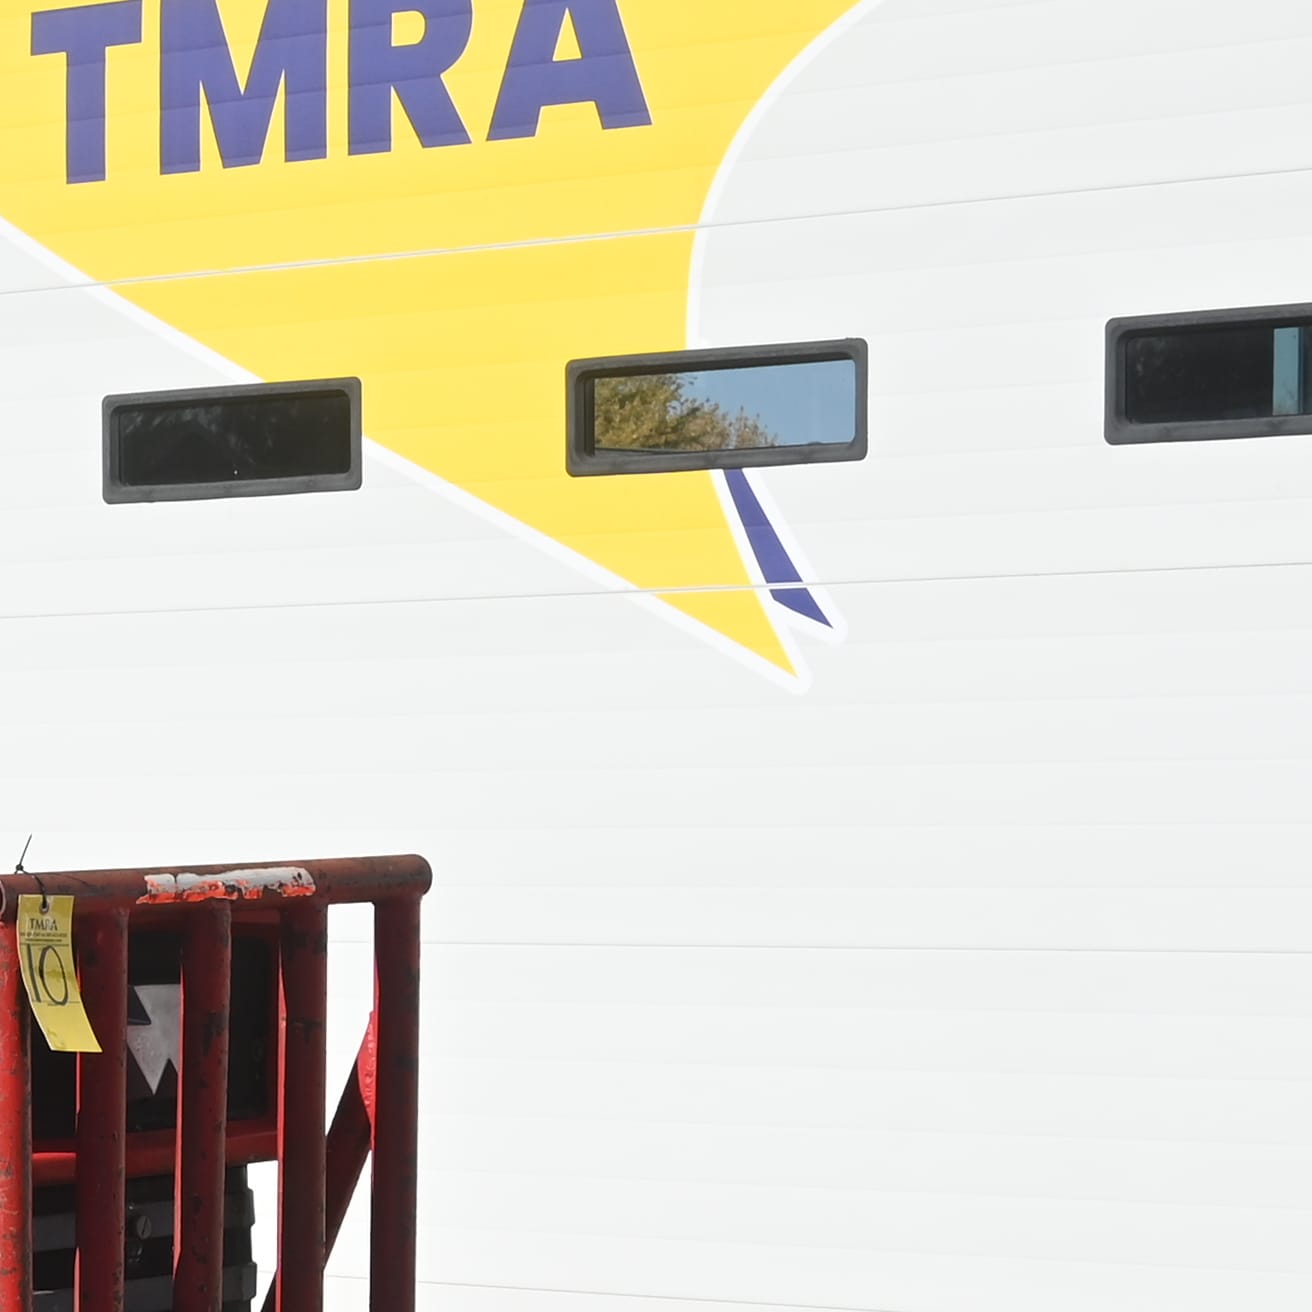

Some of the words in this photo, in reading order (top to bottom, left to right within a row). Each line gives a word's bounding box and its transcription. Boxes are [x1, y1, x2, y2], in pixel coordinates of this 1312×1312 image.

[30, 0, 652, 185] TMRA
[29, 917, 58, 931] TMRA
[26, 944, 69, 1006] 10
